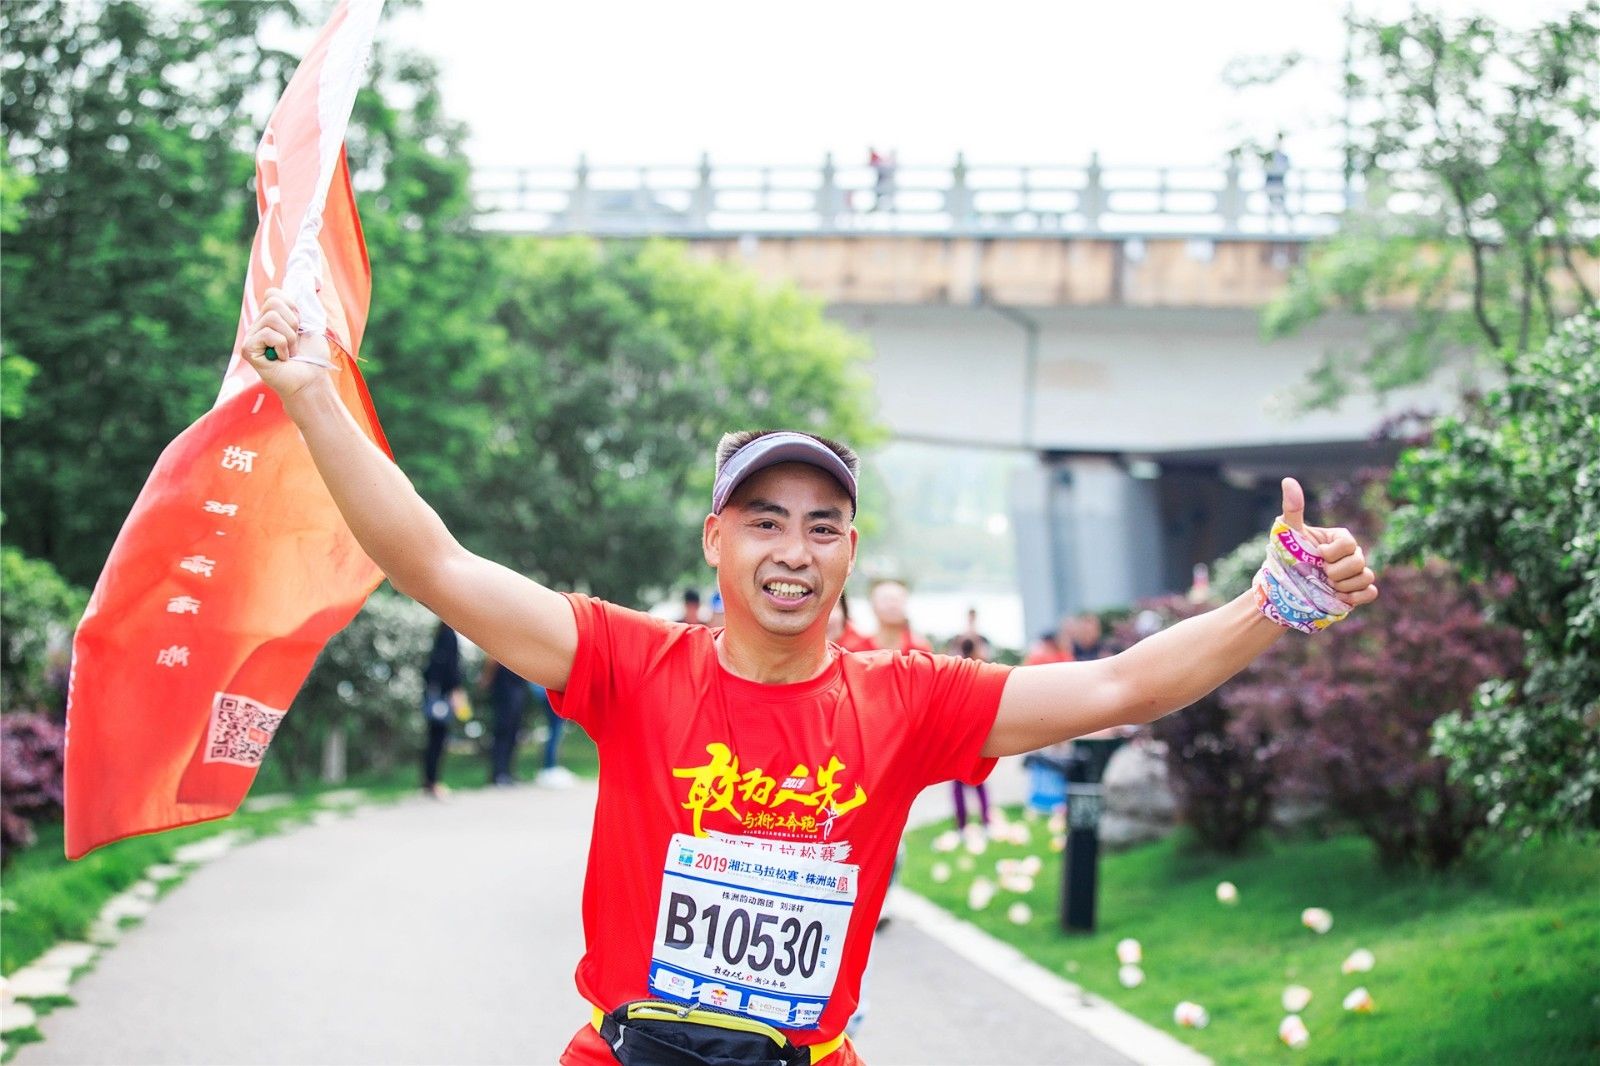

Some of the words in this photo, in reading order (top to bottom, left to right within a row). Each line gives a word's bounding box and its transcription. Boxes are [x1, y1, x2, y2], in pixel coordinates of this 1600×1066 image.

[672, 742, 867, 839] 敢为人先
[781, 776, 807, 789] 2019
[742, 810, 818, 832] 与湘江奔跑
[664, 892, 823, 979] B10530
